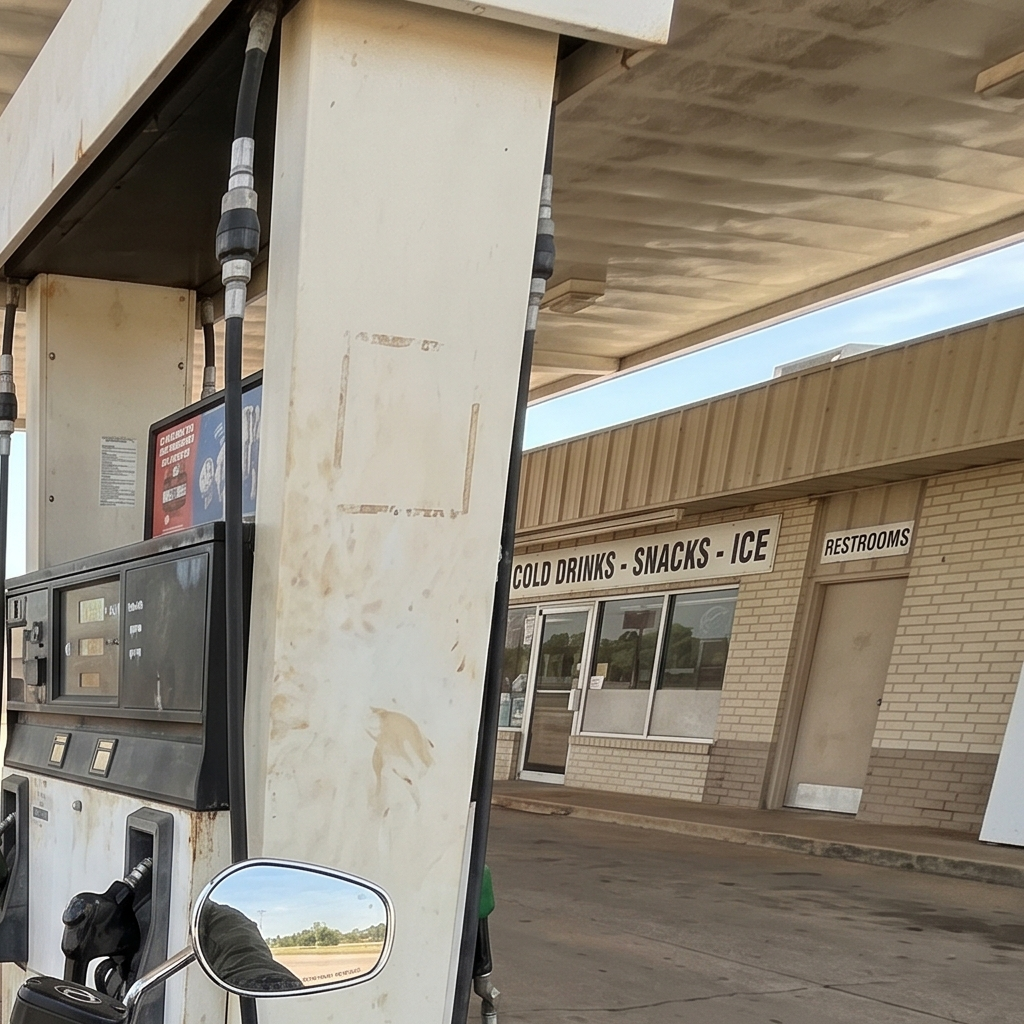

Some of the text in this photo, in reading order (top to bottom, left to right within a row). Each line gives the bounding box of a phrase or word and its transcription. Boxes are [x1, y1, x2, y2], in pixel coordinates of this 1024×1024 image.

[513, 561, 552, 590] COLD
[555, 550, 616, 585] DRINKS
[632, 537, 711, 577] SNACKS
[730, 528, 771, 565] ICE
[824, 527, 911, 557] RESTROOMS
